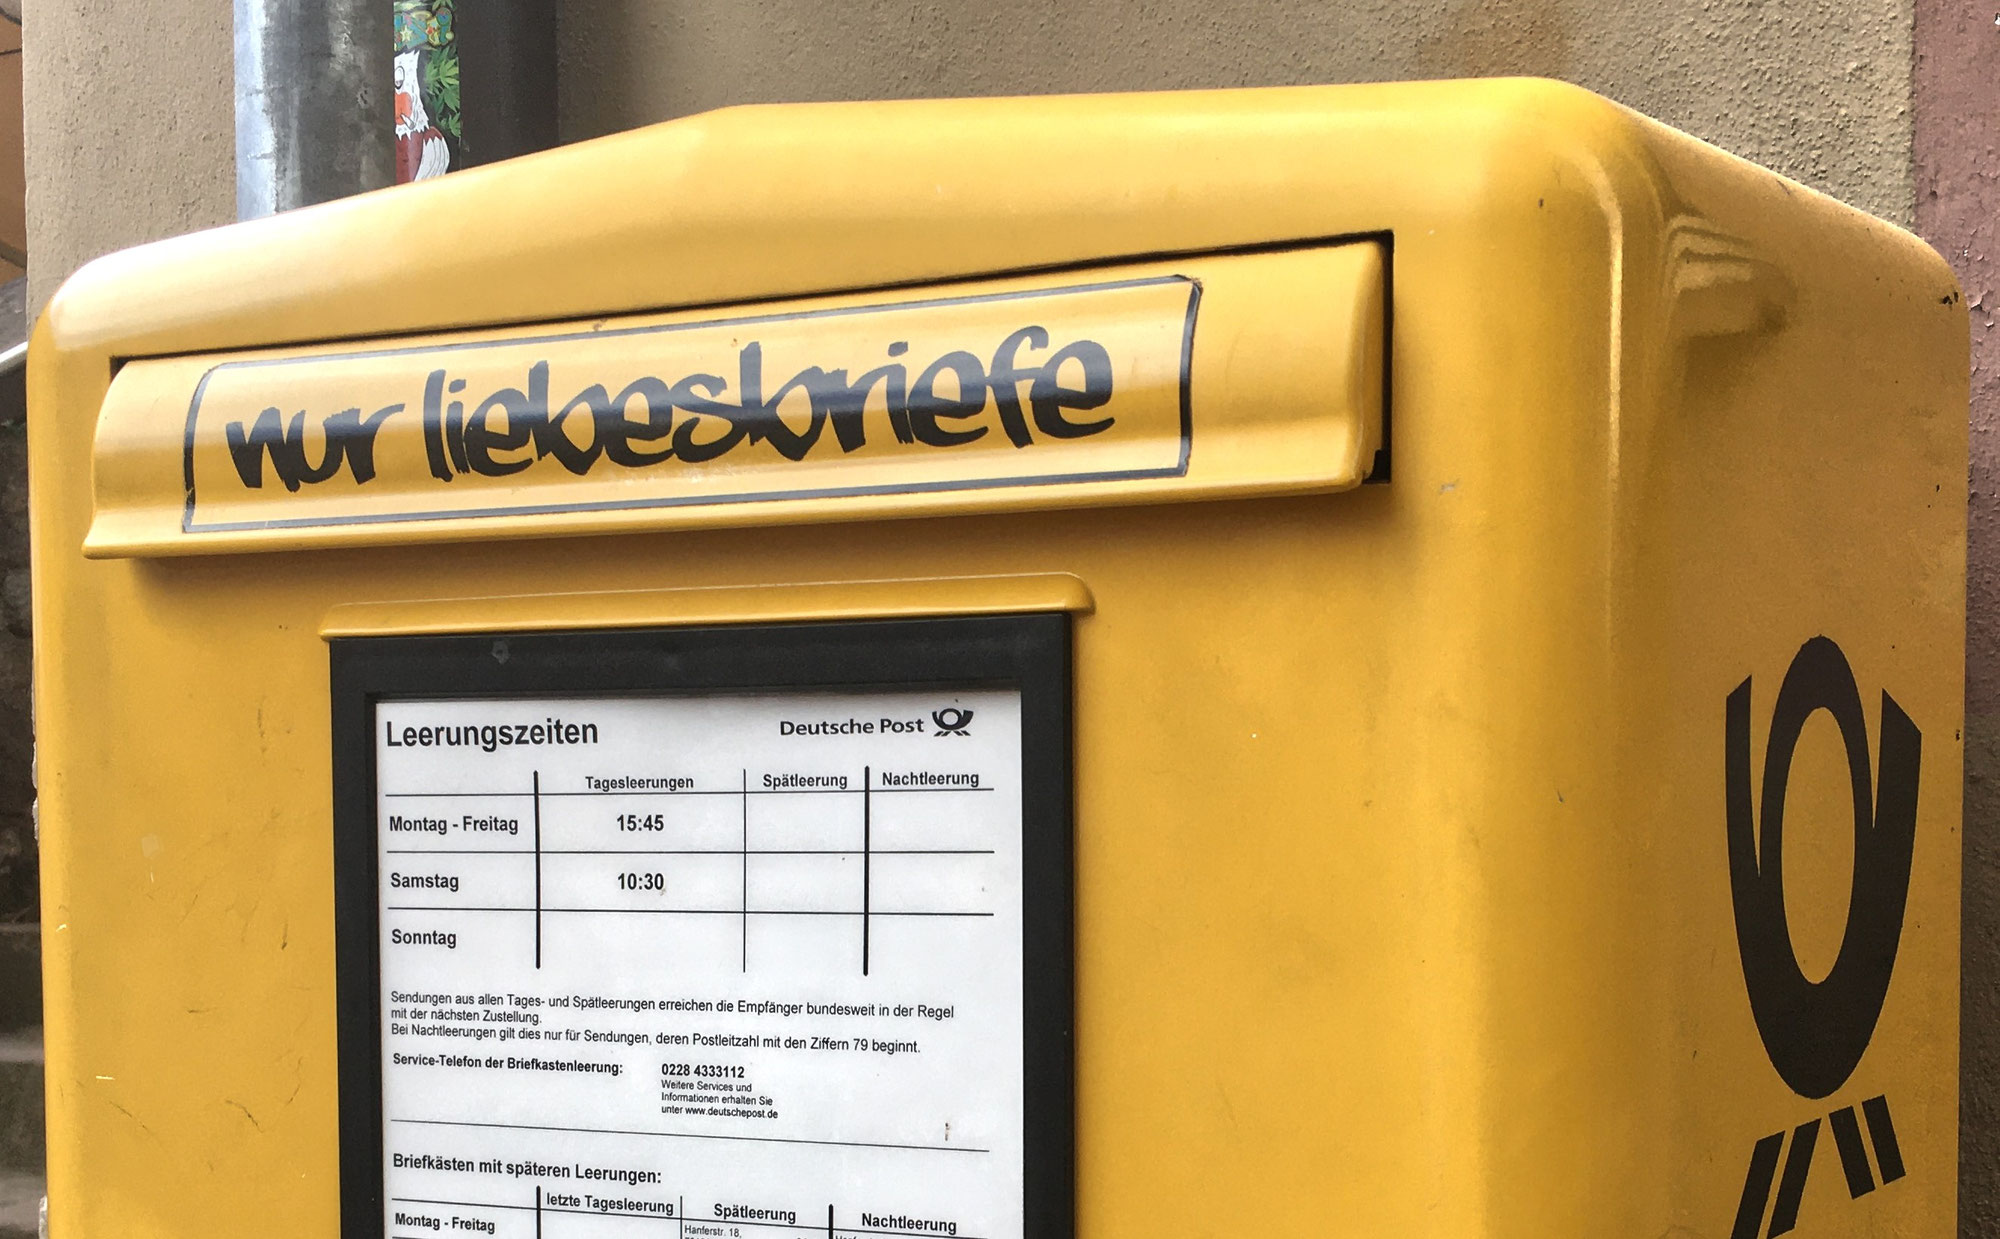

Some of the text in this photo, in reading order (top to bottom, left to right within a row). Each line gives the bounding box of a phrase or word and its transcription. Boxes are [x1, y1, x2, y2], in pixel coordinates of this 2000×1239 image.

[225, 324, 1115, 493] nur liebesbriefe
[386, 718, 598, 752] Leerungszeiten
[780, 718, 924, 736] Deutsche Post
[585, 775, 694, 792] Tagesleerungen
[762, 773, 848, 790] Spätleerung
[882, 772, 980, 788] Nachtleerung
[389, 816, 447, 835] Montag
[463, 816, 519, 835] Freitag
[616, 814, 664, 832] 15:45
[390, 872, 459, 892] Samstag
[617, 873, 664, 890] 10:30
[391, 929, 457, 949] Sonntag
[391, 991, 955, 1021] Sendungen aus allen Tages- und Spätleerungen erreichen die Empfänger bundesweit in der Regel
[391, 1008, 543, 1026] mit der nächsten Zustellung.
[391, 1023, 921, 1055] Bei Nachtleerungen gilt dies nur für Sendungen, deren Postleitzahl mit den Ziffern 79 beginnt.
[392, 1052, 624, 1075] Service-Telefon der Briefkastenleerung:
[661, 1063, 745, 1078] 0228 4333112
[661, 1079, 752, 1093] Weitere Services und
[661, 1091, 773, 1106] Informationen erhalten Sie
[661, 1105, 779, 1120] unter www.deutschepost.de
[393, 1153, 662, 1185] Briefkästen mit späteren Leerungen:
[546, 1192, 674, 1216] letzte Tagesleerung
[713, 1203, 797, 1224] Spätleerung
[395, 1212, 440, 1230] Montag
[451, 1216, 495, 1234] Freitag
[861, 1213, 958, 1235] Nachtleerung
